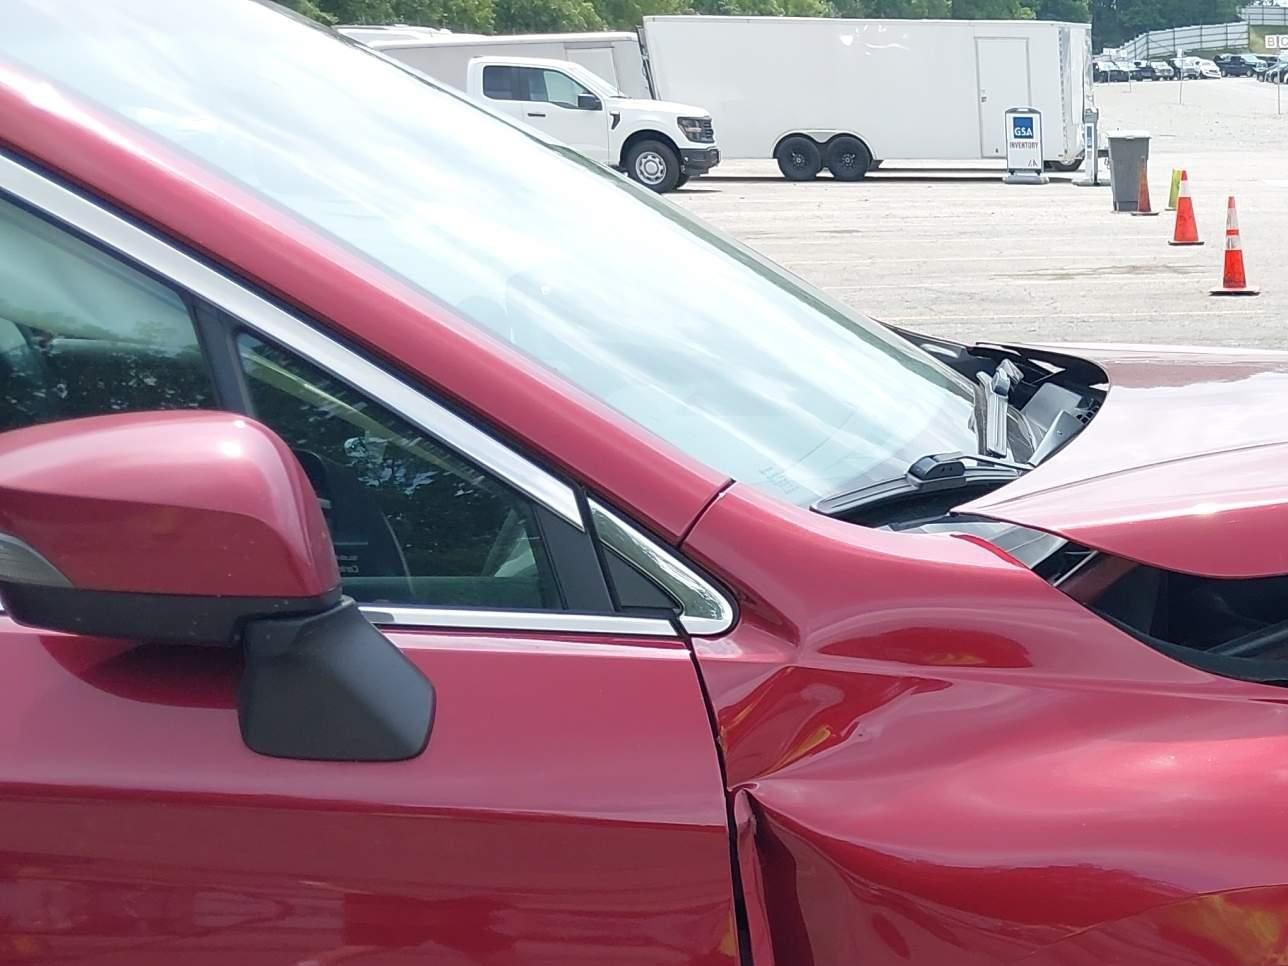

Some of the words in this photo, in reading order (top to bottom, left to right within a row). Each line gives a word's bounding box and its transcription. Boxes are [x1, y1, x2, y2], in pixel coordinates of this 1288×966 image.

[1267, 37, 1275, 47] B
[1280, 37, 1288, 47] C
[1014, 127, 1032, 136] GSA
[1009, 141, 1039, 150] INVENTORY
